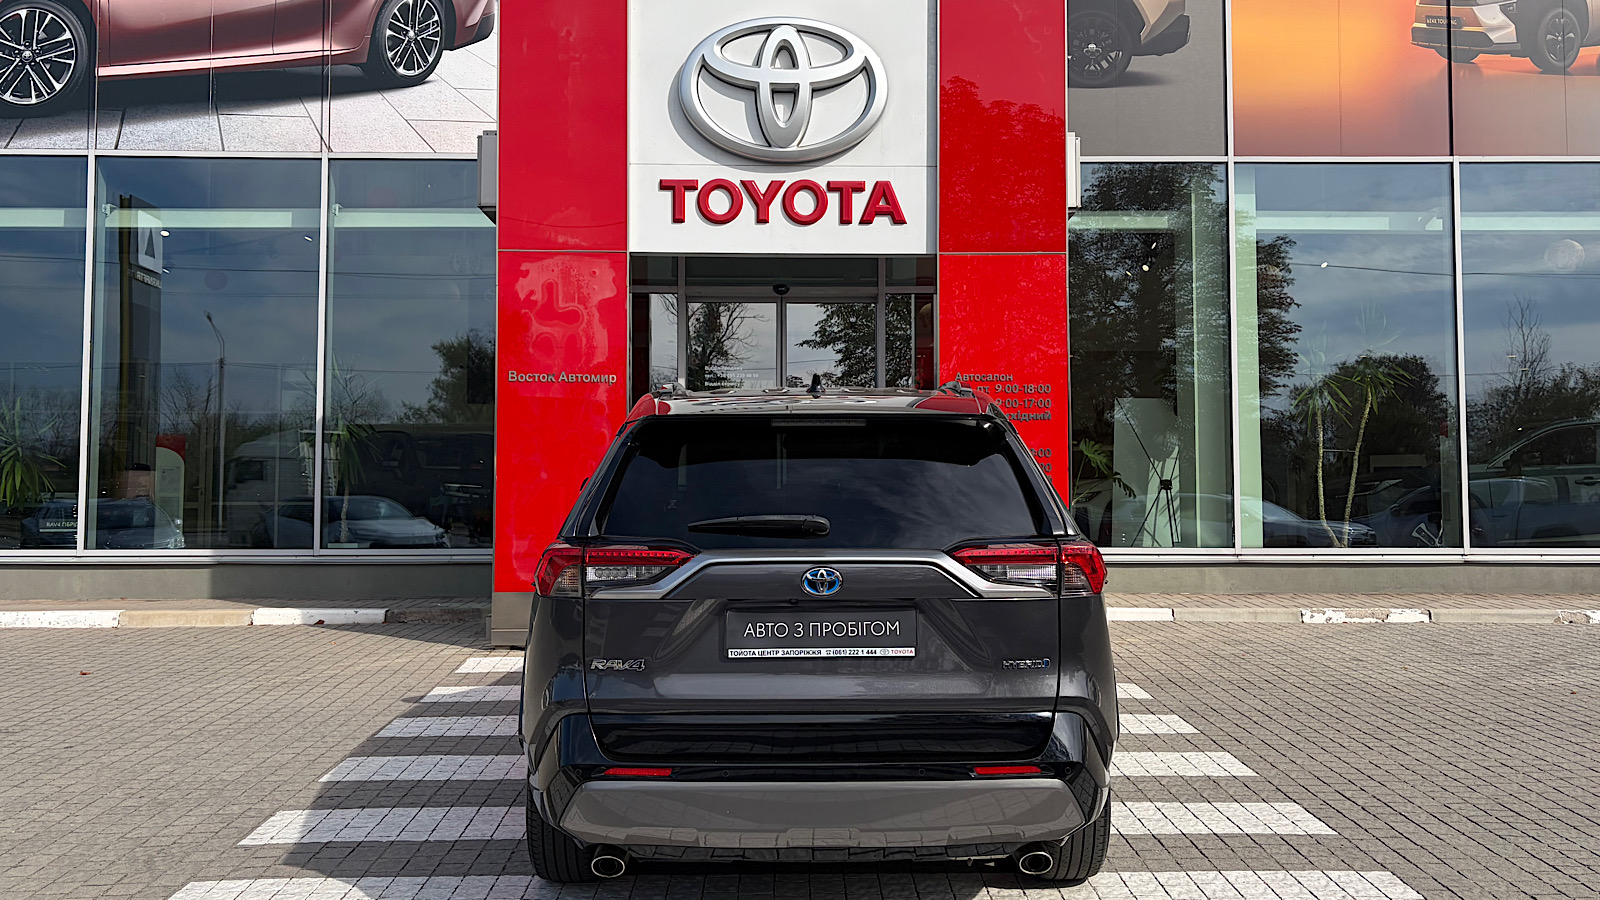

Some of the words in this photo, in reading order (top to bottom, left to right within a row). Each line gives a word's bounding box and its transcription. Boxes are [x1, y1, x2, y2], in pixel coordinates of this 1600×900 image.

[659, 178, 907, 225] TOYOTA
[508, 370, 556, 382] Восток
[558, 371, 617, 386] Автомир
[955, 372, 1013, 382] Автосалон
[743, 622, 789, 638] АВТО
[793, 622, 804, 637] З
[809, 621, 900, 637] ПРОБІГОМ
[591, 659, 646, 671] RAV4
[1002, 659, 1044, 669] HYBRID
